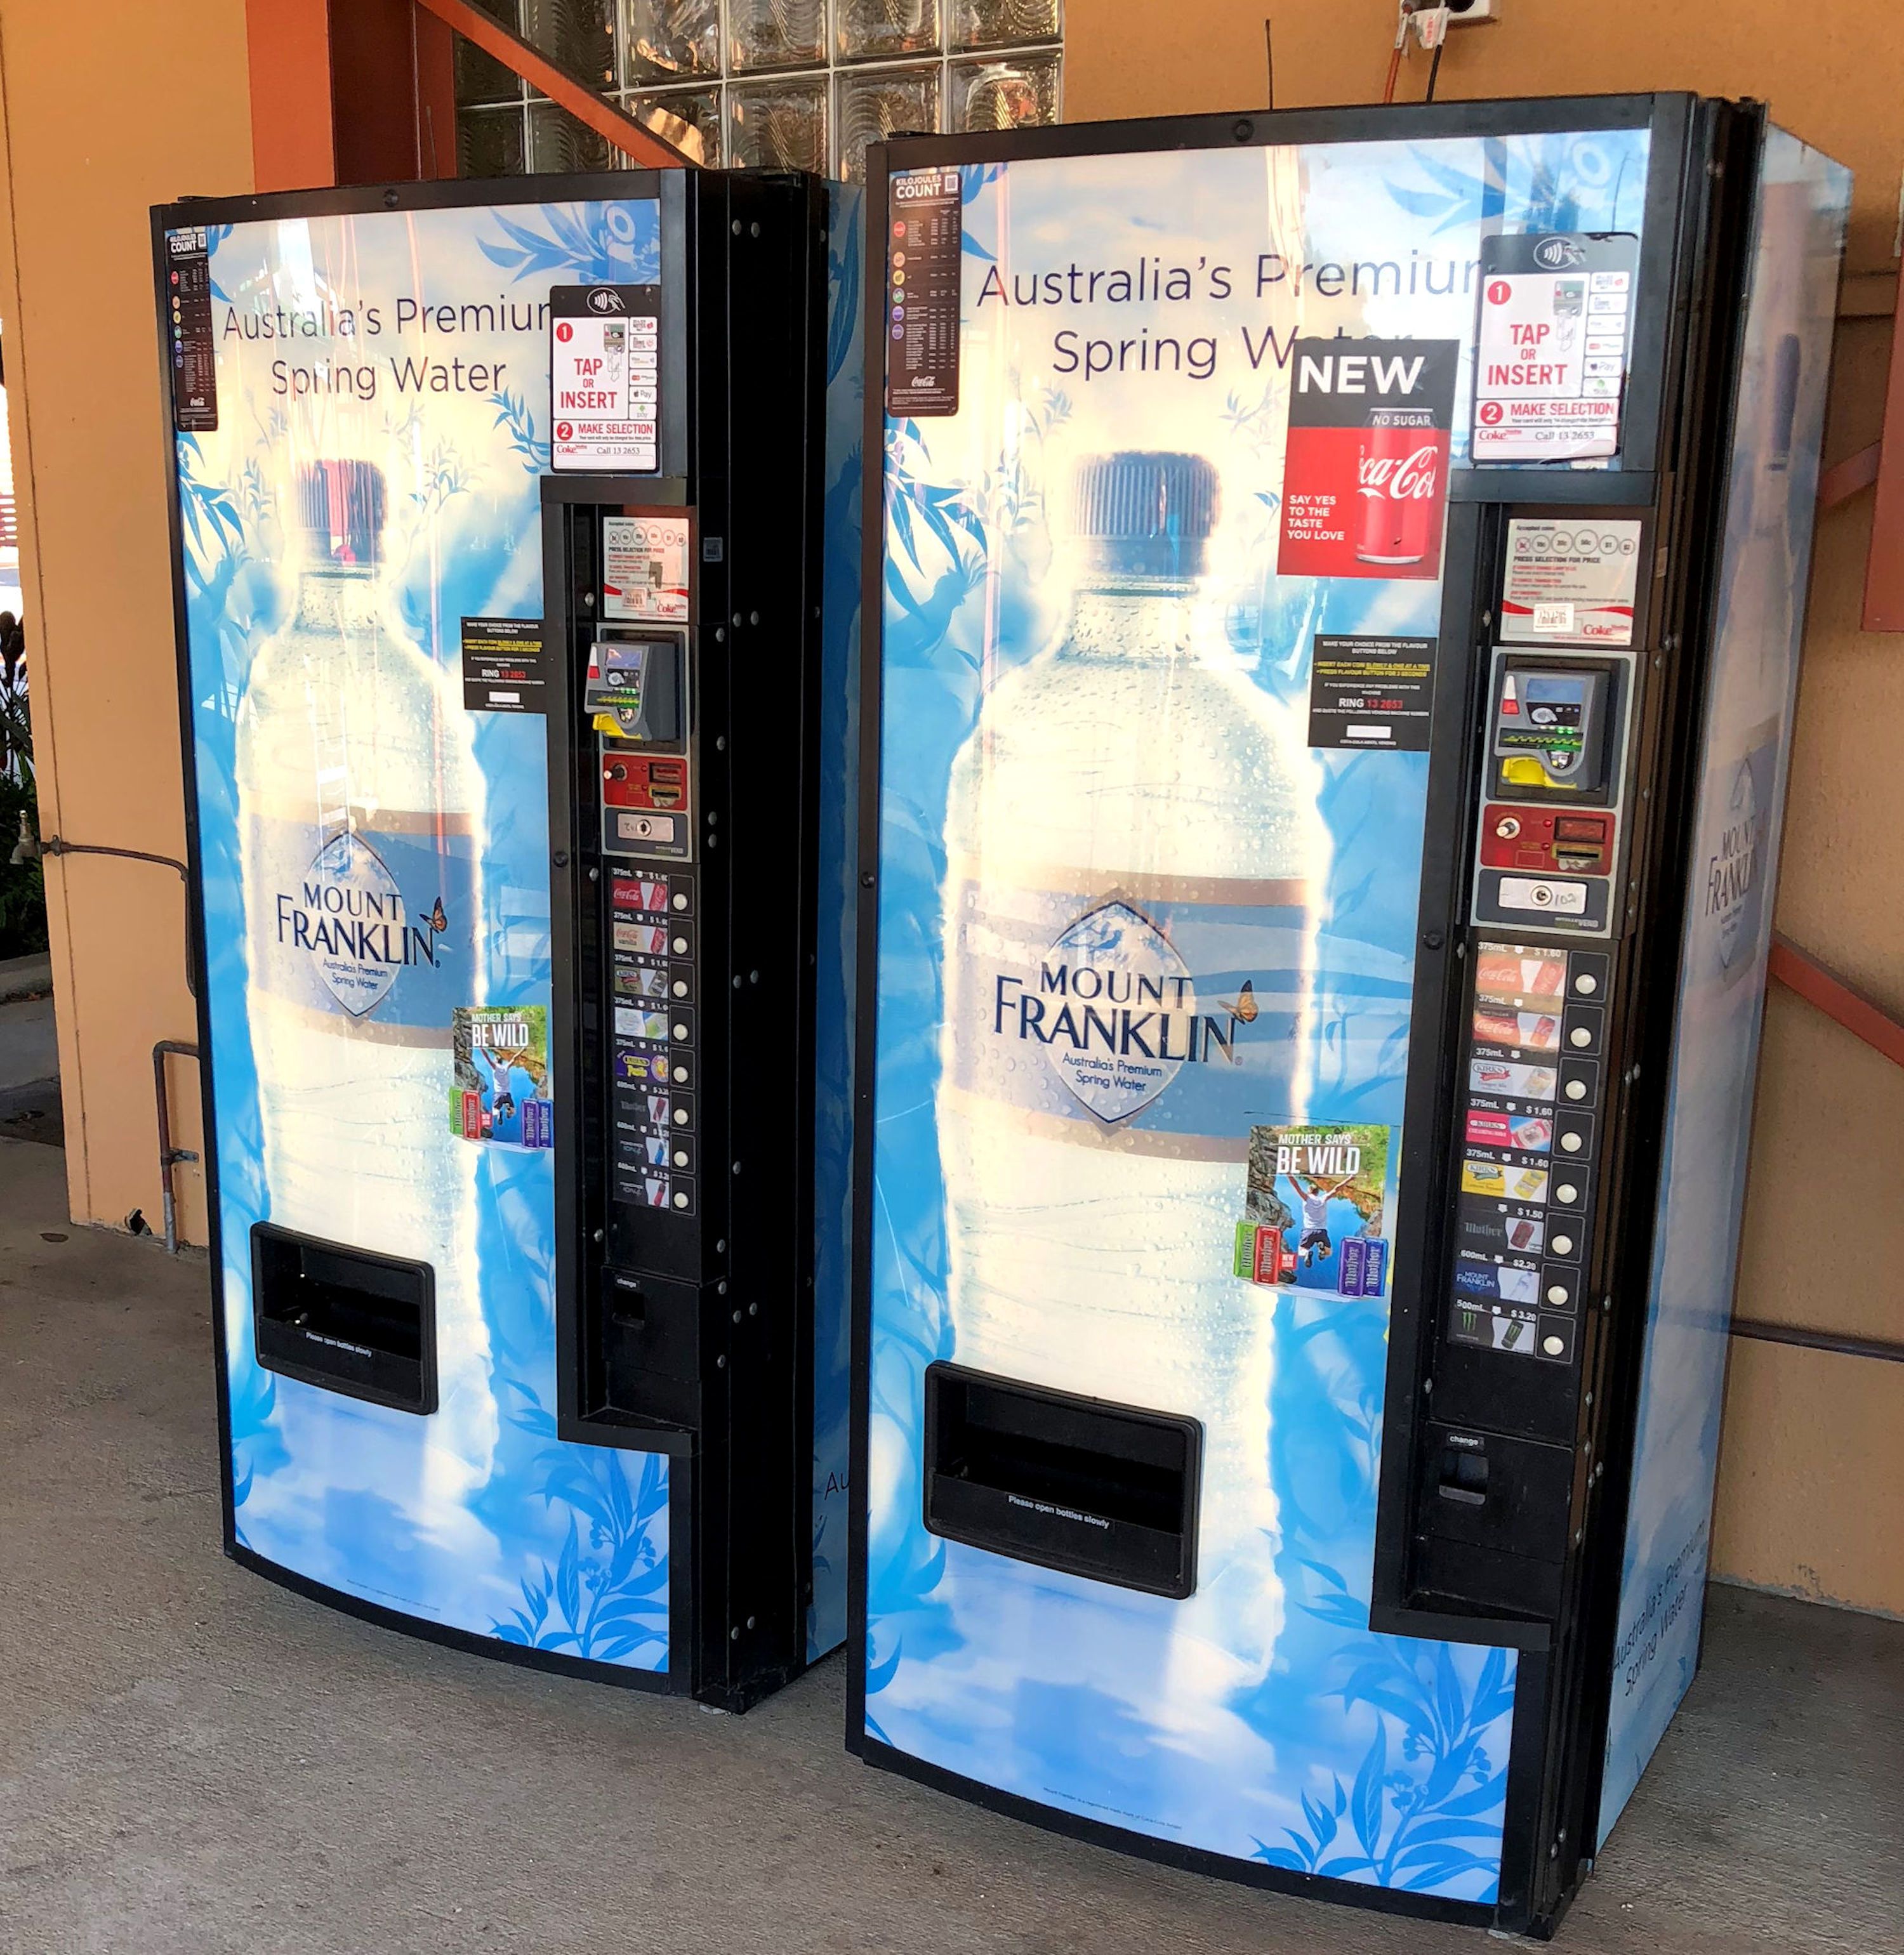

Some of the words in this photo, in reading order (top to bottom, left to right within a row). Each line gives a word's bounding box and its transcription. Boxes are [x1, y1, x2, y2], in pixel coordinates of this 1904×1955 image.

[896, 174, 941, 186] KILOJOULES
[896, 183, 941, 199] COUNT
[171, 240, 197, 253] COUNT
[976, 257, 1232, 307] Australia's
[223, 300, 381, 340] Australia's
[1510, 324, 1550, 345] TAP
[1053, 327, 1217, 381] Spring
[1521, 349, 1536, 360] OR
[574, 359, 602, 376] TAP
[272, 358, 376, 400] Spring
[390, 356, 506, 392] Water
[1299, 355, 1425, 395] NEW
[1488, 364, 1568, 385] INSERT
[583, 379, 594, 388] OR
[560, 392, 617, 409] INSERT
[640, 390, 652, 399] Pay
[1511, 404, 1545, 416] MAKE
[1550, 403, 1613, 416] SELECTION
[1372, 415, 1389, 426] NO
[1393, 415, 1431, 426] SUGAR
[578, 424, 604, 434] MAKE
[606, 424, 653, 434] SELECTION
[1479, 431, 1507, 440] Coke
[1535, 431, 1554, 440] Call
[1559, 431, 1569, 440] 13
[1572, 431, 1594, 439] 2653
[557, 445, 577, 454] Coke
[1290, 494, 1311, 504] SAY
[1315, 495, 1336, 505] YES
[1290, 506, 1304, 516] TO
[1308, 507, 1330, 517] THE
[1288, 518, 1323, 528] TASTE
[1287, 530, 1311, 540] YOU
[1314, 531, 1344, 541] LOVE
[657, 603, 676, 613] Coke
[1583, 624, 1612, 635] Coke
[482, 669, 499, 678] RING
[1339, 698, 1365, 708] RING
[1367, 699, 1378, 709] 13
[1380, 700, 1403, 709] 2653
[612, 867, 633, 877] 375mL
[613, 888, 640, 901] Coca-Cola
[303, 882, 402, 921] MOUNT
[613, 911, 633, 921] 375mL
[277, 893, 434, 966] FRANKLIN
[1478, 942, 1507, 952] 375mL
[323, 959, 355, 974] Australia's
[358, 964, 388, 977] Premium
[1478, 967, 1516, 982] Coca-Cola
[332, 973, 354, 988] Spring
[357, 977, 378, 990] Water
[1040, 961, 1193, 1009] MOUNT
[1479, 994, 1506, 1005] 375mL
[472, 1013, 501, 1022] MOTHER
[503, 1013, 522, 1022] SAYS
[995, 975, 1236, 1065] FRANKLIN
[1475, 1020, 1514, 1035] Coca-Cola
[472, 1024, 489, 1047] BE
[493, 1024, 529, 1047] WILD
[1476, 1048, 1504, 1057] 375mL
[1062, 1052, 1114, 1072] Australia's
[1118, 1060, 1162, 1077] Premium
[1076, 1069, 1110, 1089] Spring
[1113, 1075, 1146, 1092] Water
[1470, 1098, 1499, 1109] 375mL
[1526, 1105, 1532, 1114] $
[1534, 1107, 1553, 1116] 1.60
[1278, 1134, 1322, 1144] MOTHER
[1325, 1134, 1352, 1144] SAYS
[1277, 1146, 1301, 1174] BE
[1307, 1147, 1360, 1175] WILD
[1466, 1149, 1495, 1160] 375mL
[1521, 1156, 1528, 1164] $
[1530, 1158, 1549, 1168] 1.60
[1517, 1207, 1523, 1216] $
[1526, 1209, 1544, 1219] 1.50
[1460, 1249, 1488, 1261] 600mL
[1513, 1259, 1536, 1270] $2.20
[1366, 1246, 1380, 1288] Mother
[1457, 1274, 1495, 1287] FRANKLIN
[1465, 1271, 1489, 1280] MOUNT
[1457, 1299, 1485, 1312] 500mL
[1511, 1309, 1517, 1318] $
[1519, 1310, 1537, 1321] 3.20
[1449, 1435, 1479, 1446] change
[1008, 1495, 1034, 1508] Please
[1035, 1504, 1054, 1513] open
[1055, 1508, 1083, 1521] bottles
[1083, 1515, 1110, 1529] slowly
[1625, 1633, 1657, 1697] Spring
